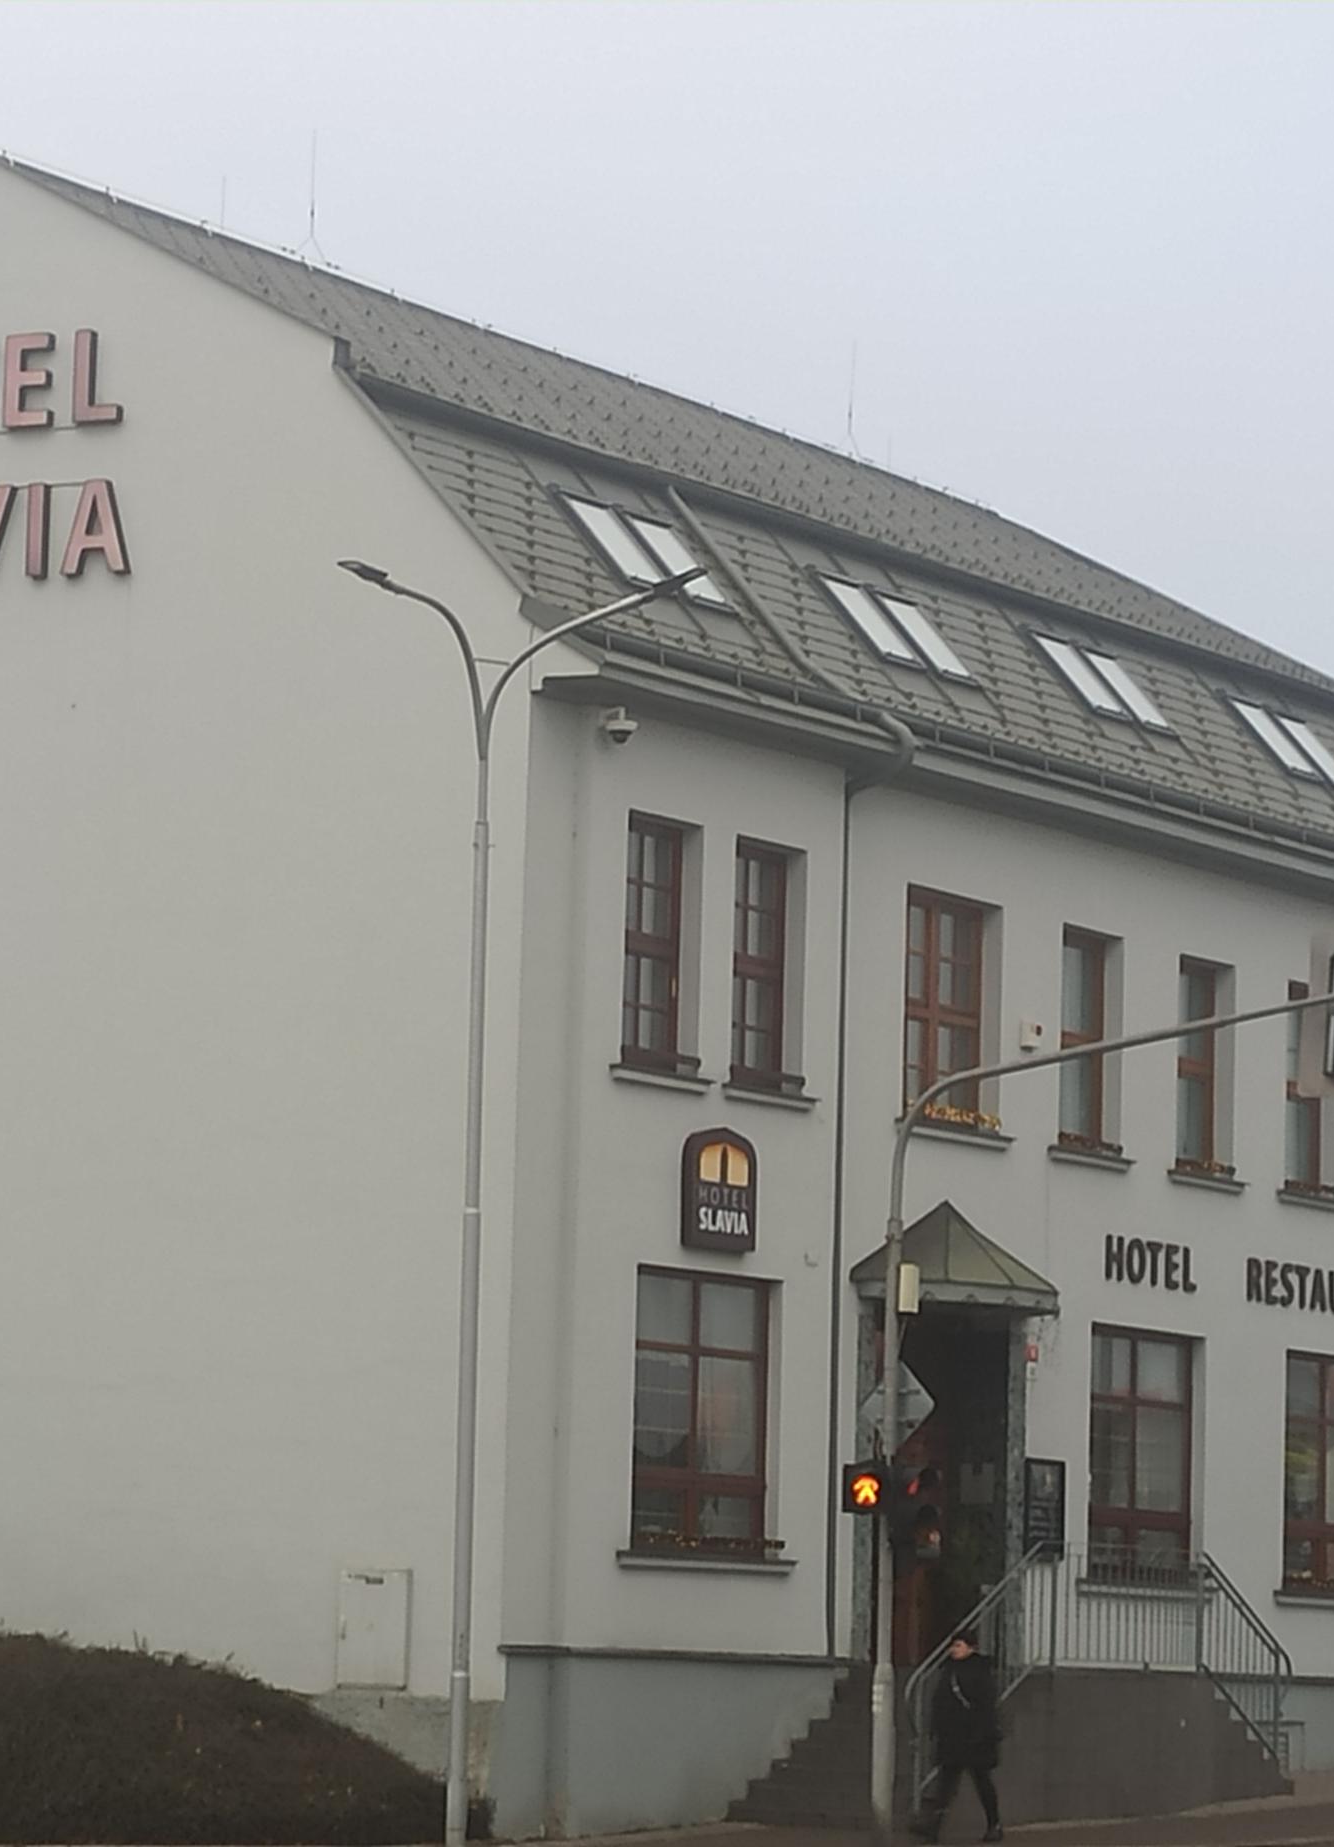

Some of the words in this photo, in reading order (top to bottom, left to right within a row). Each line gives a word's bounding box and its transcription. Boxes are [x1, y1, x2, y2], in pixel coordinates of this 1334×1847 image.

[698, 1185, 748, 1209] HOTEL
[698, 1206, 749, 1236] SLAVIA
[1104, 1233, 1198, 1294] HOTEL
